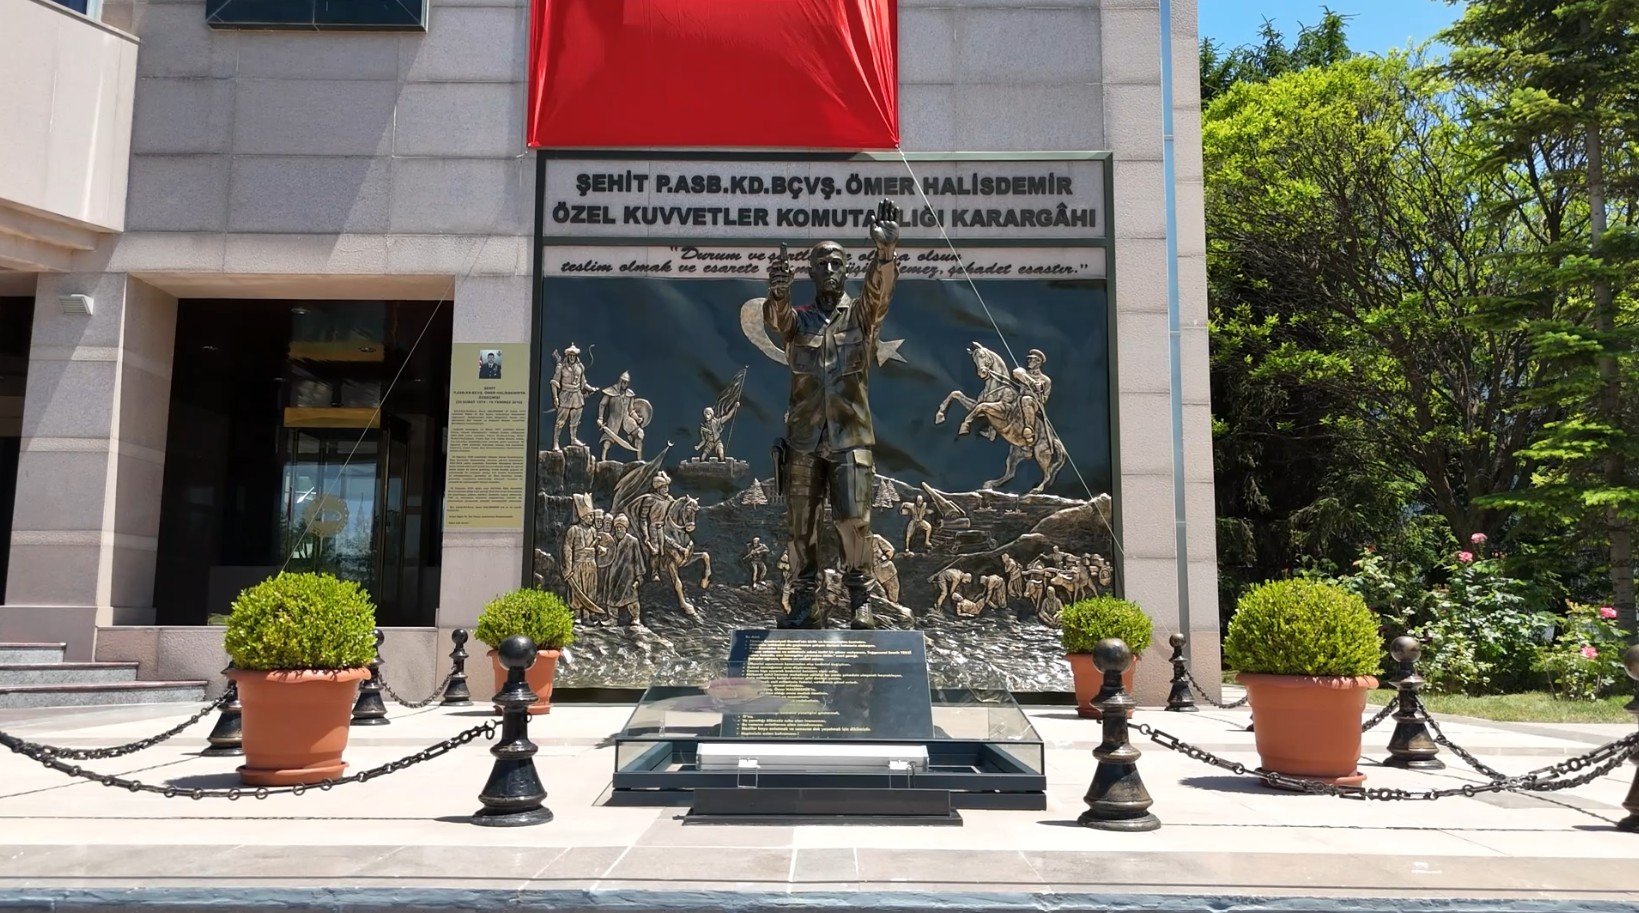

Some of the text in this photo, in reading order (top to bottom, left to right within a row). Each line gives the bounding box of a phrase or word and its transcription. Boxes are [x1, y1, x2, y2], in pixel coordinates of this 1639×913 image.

[576, 170, 1073, 199] ŞEHİT P.ASB.KD.BÇVŞ. ÖMER HALİSDEMİR
[552, 201, 1096, 227] ÖZEL KUVVETLER KOMUTALIĞI KARARGÂHI
[748, 252, 765, 260] ve
[917, 250, 961, 262] olsun
[561, 259, 613, 273] teslim
[619, 259, 672, 273] olmak
[678, 264, 696, 273] ve
[703, 263, 759, 274] esarete
[947, 262, 1012, 277] şehadet
